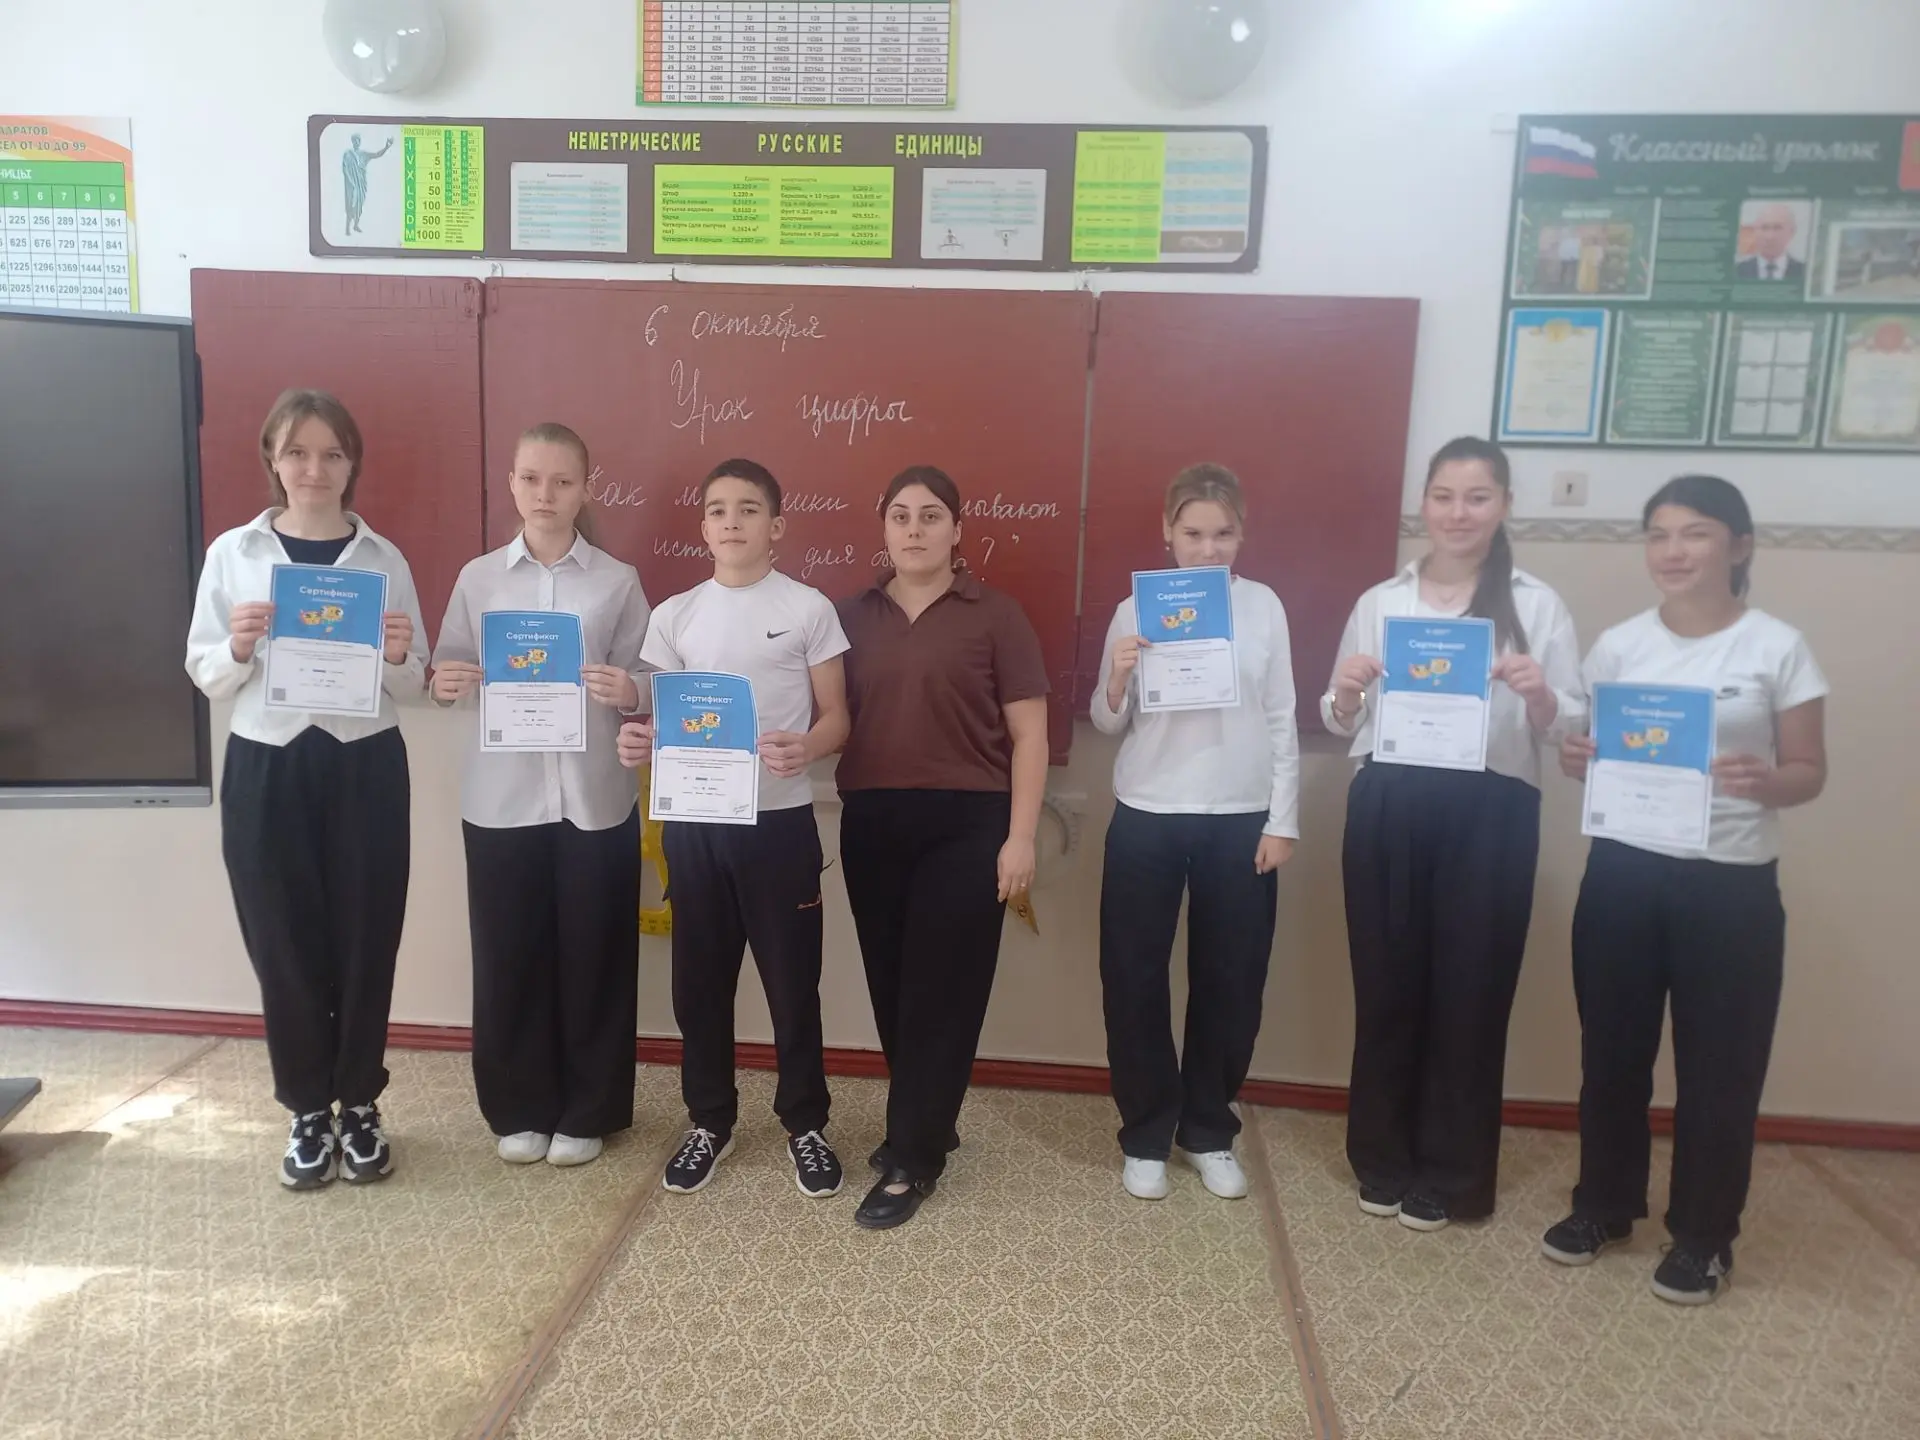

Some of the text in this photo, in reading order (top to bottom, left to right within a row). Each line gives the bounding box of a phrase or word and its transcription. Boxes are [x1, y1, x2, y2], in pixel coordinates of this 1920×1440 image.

[20, 141, 33, 150] ОТ
[38, 142, 50, 151] 10
[55, 142, 69, 151] ДО
[434, 141, 440, 151] 1
[568, 130, 983, 157] НЕМЕТРИЧЕСКИЕ РУССКИЕ ЕДИНИЦЫ
[1608, 132, 1768, 162] Классный
[406, 155, 440, 165] V 5
[407, 170, 440, 181] X 10
[407, 186, 440, 196] L 50
[37, 192, 43, 201] 6
[61, 192, 67, 201] 7
[84, 193, 91, 202] 8
[109, 193, 116, 202] 9
[422, 201, 440, 210] 100
[9, 215, 121, 227] 225 256 289 324 361
[406, 215, 440, 225] D 500
[416, 230, 440, 239] 1000
[10, 238, 122, 249] 625 676 729 784 841
[9, 262, 30, 271] 1225
[33, 263, 54, 272] 1296
[57, 264, 78, 272] 1369
[81, 264, 102, 273] 1444
[106, 265, 126, 273] 1521
[10, 284, 31, 292] 2025
[34, 285, 55, 293] 2116
[58, 285, 79, 294] 2209
[82, 286, 103, 294] 2304
[107, 287, 128, 295] 2401
[644, 304, 669, 346] 6
[670, 359, 755, 445] Урок
[801, 544, 856, 580] для
[299, 586, 359, 600] Сертификат
[506, 631, 560, 642] Сертификат
[679, 693, 734, 704] Сертификат
